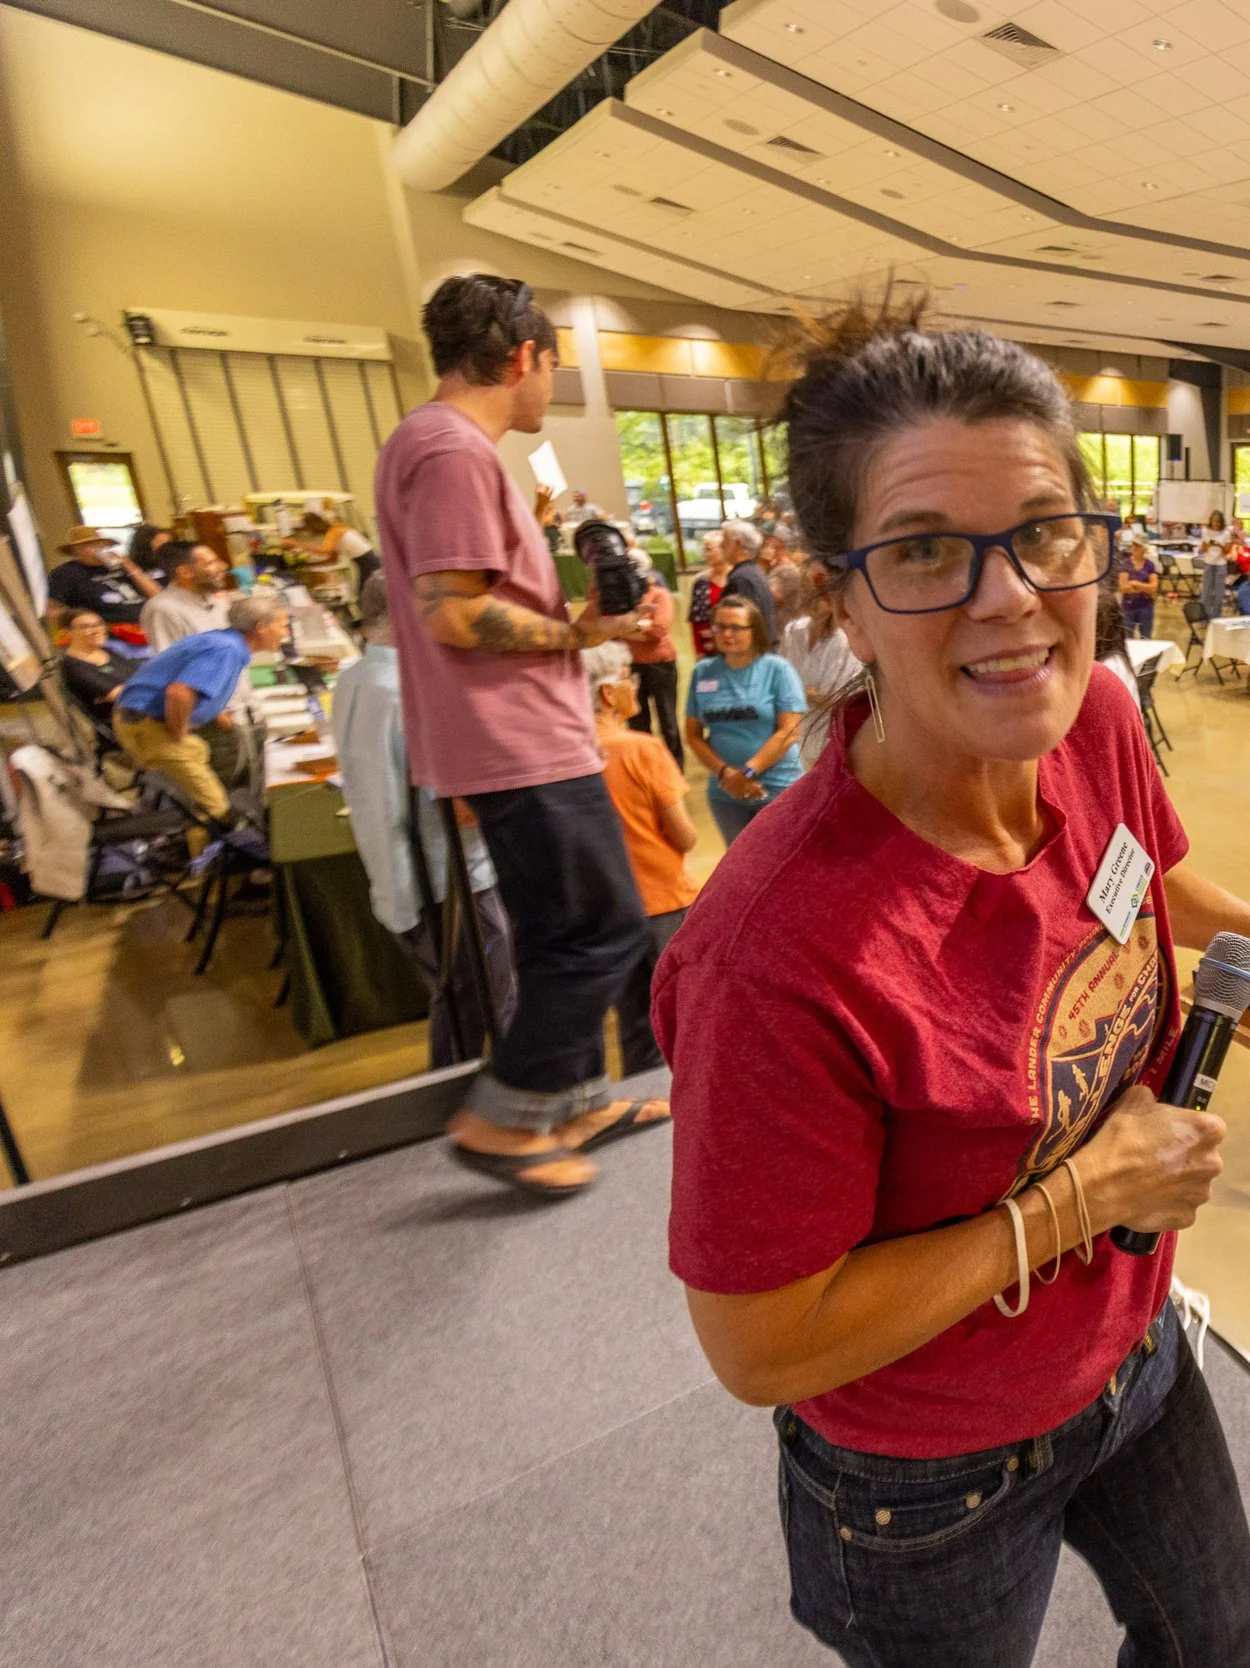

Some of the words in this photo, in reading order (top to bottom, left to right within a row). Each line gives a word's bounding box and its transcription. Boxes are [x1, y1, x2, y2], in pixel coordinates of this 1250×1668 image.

[1099, 875, 1116, 904] Mary
[1110, 841, 1129, 876] Greene
[1104, 878, 1125, 915] Executive
[1119, 847, 1137, 880] Director
[1027, 1026, 1042, 1090] LANDER
[1035, 950, 1077, 1024] COMMUNITY
[1067, 989, 1091, 1021] 45TH
[1088, 951, 1120, 991] ANNUAL
[1155, 1026, 1180, 1065] MILE
